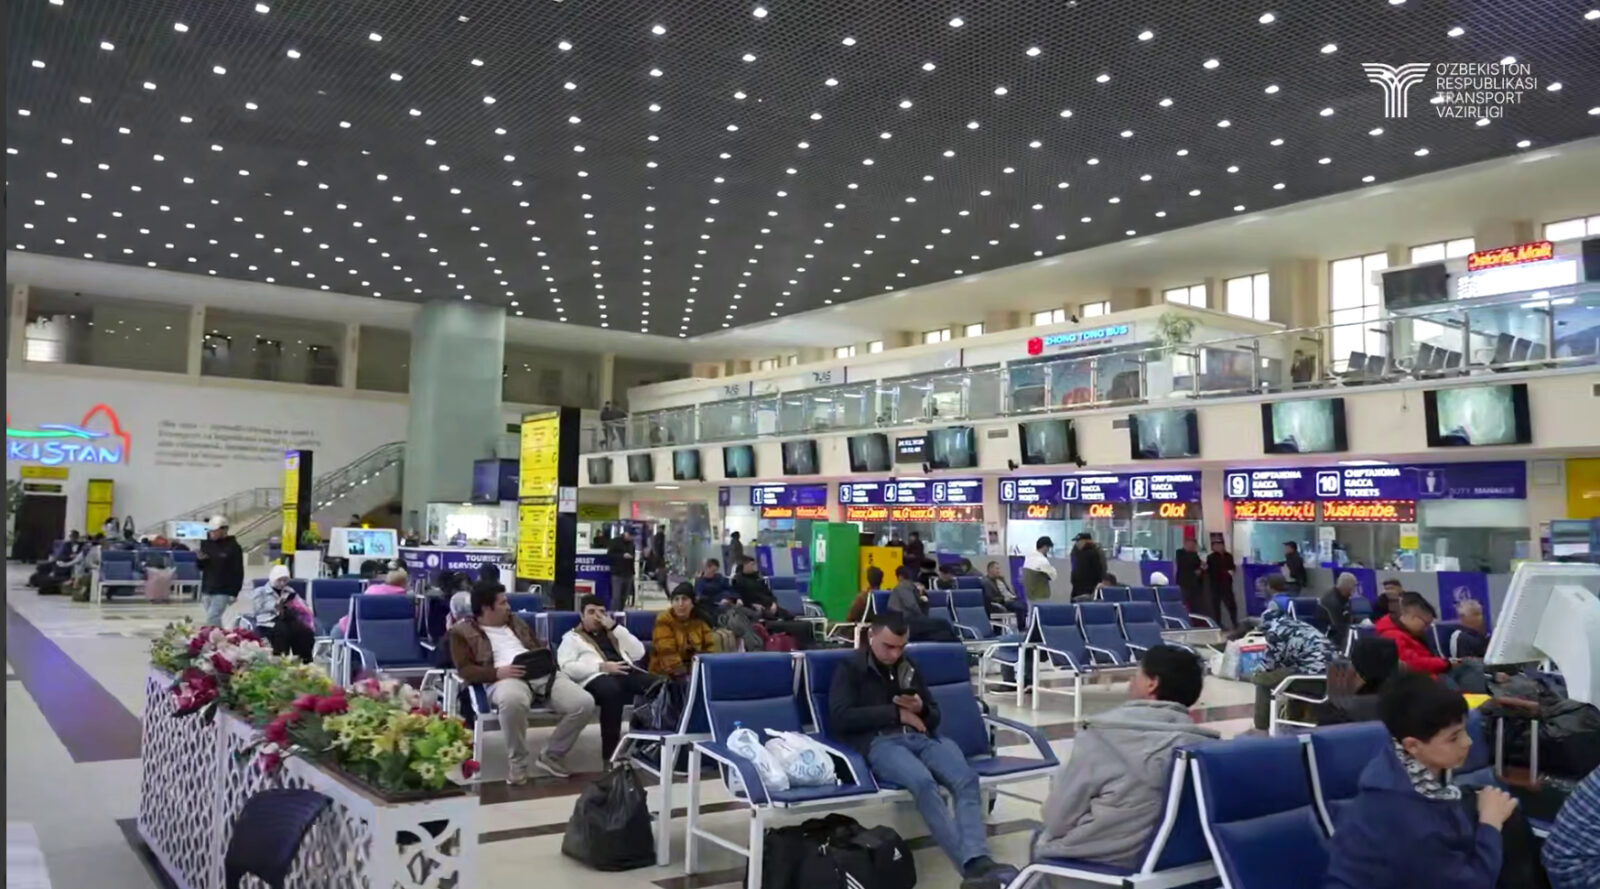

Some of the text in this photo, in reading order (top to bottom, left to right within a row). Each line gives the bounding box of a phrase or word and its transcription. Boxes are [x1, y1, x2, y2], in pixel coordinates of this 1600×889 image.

[8, 440, 122, 465] KISTAN
[1027, 504, 1048, 518] Olot
[1089, 503, 1113, 518] Olot
[1159, 502, 1186, 517] Olot
